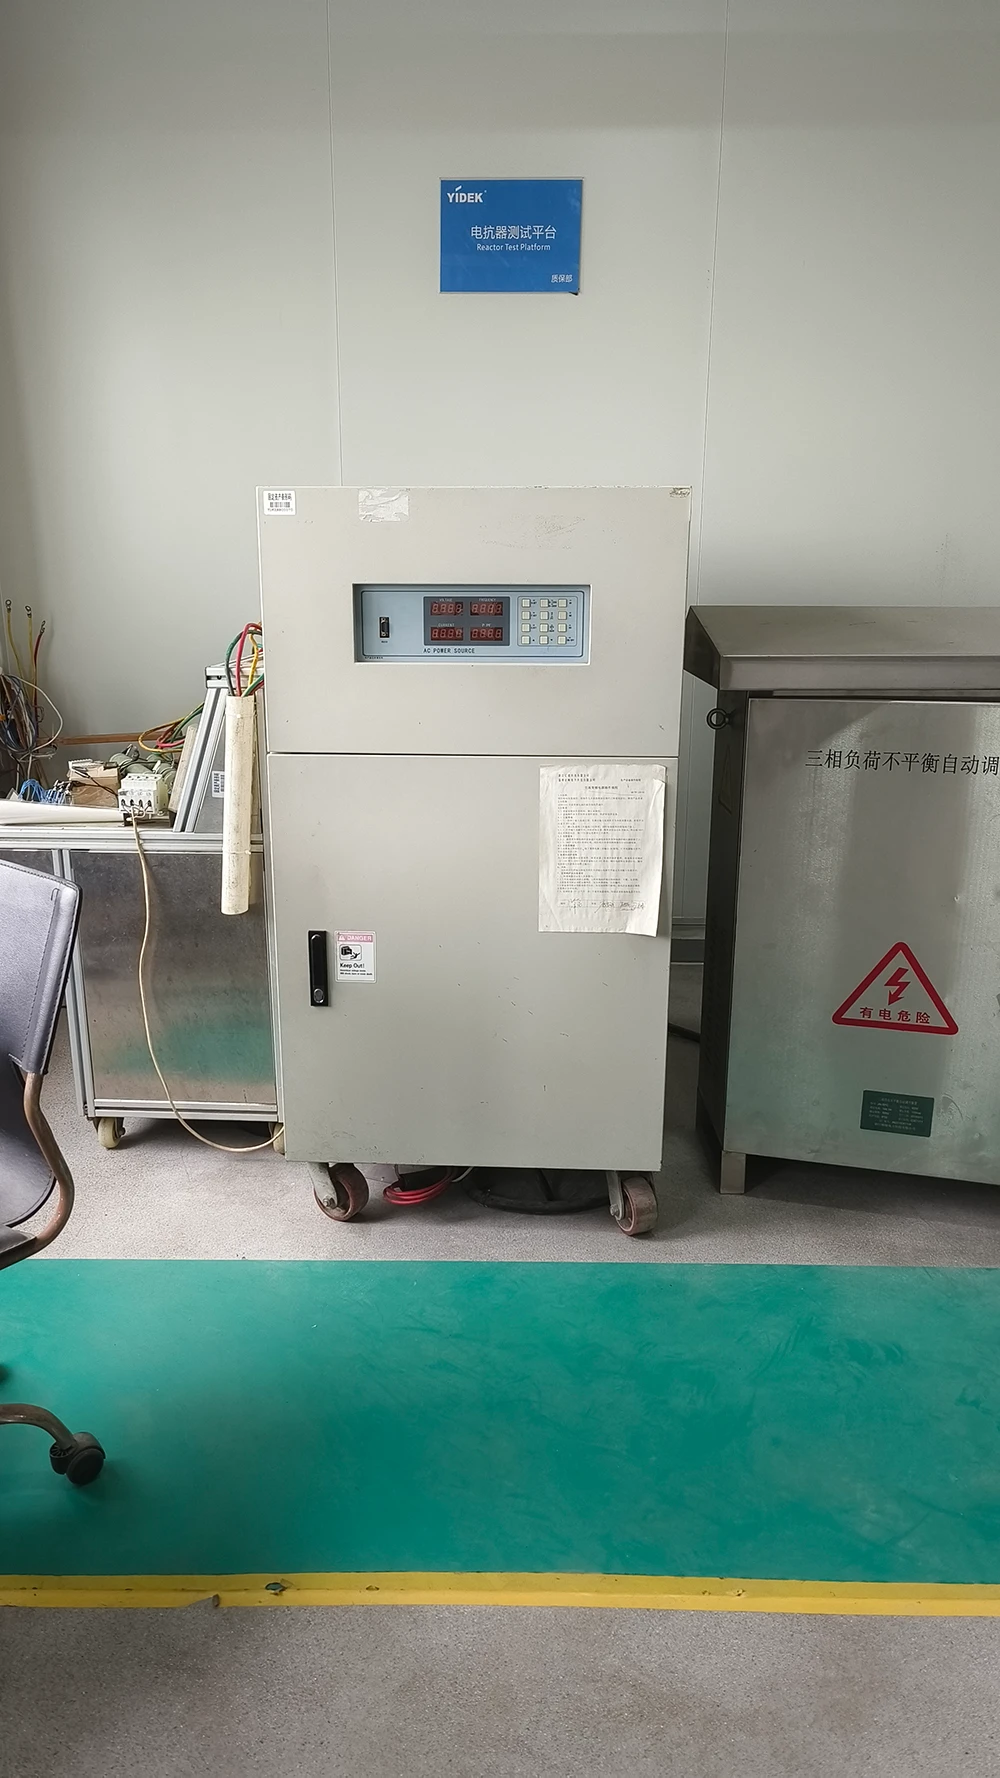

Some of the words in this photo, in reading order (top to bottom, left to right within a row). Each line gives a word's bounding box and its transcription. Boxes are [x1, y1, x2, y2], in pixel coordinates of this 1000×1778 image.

[471, 225, 557, 240] 电抗器测试平台
[477, 243, 504, 251] Reactor
[505, 243, 519, 251] Test
[520, 243, 551, 251] Platform
[551, 274, 573, 283] 质保部
[805, 749, 1000, 776] 三相负荷不平衡自动调
[859, 1006, 931, 1024] 有电危险
